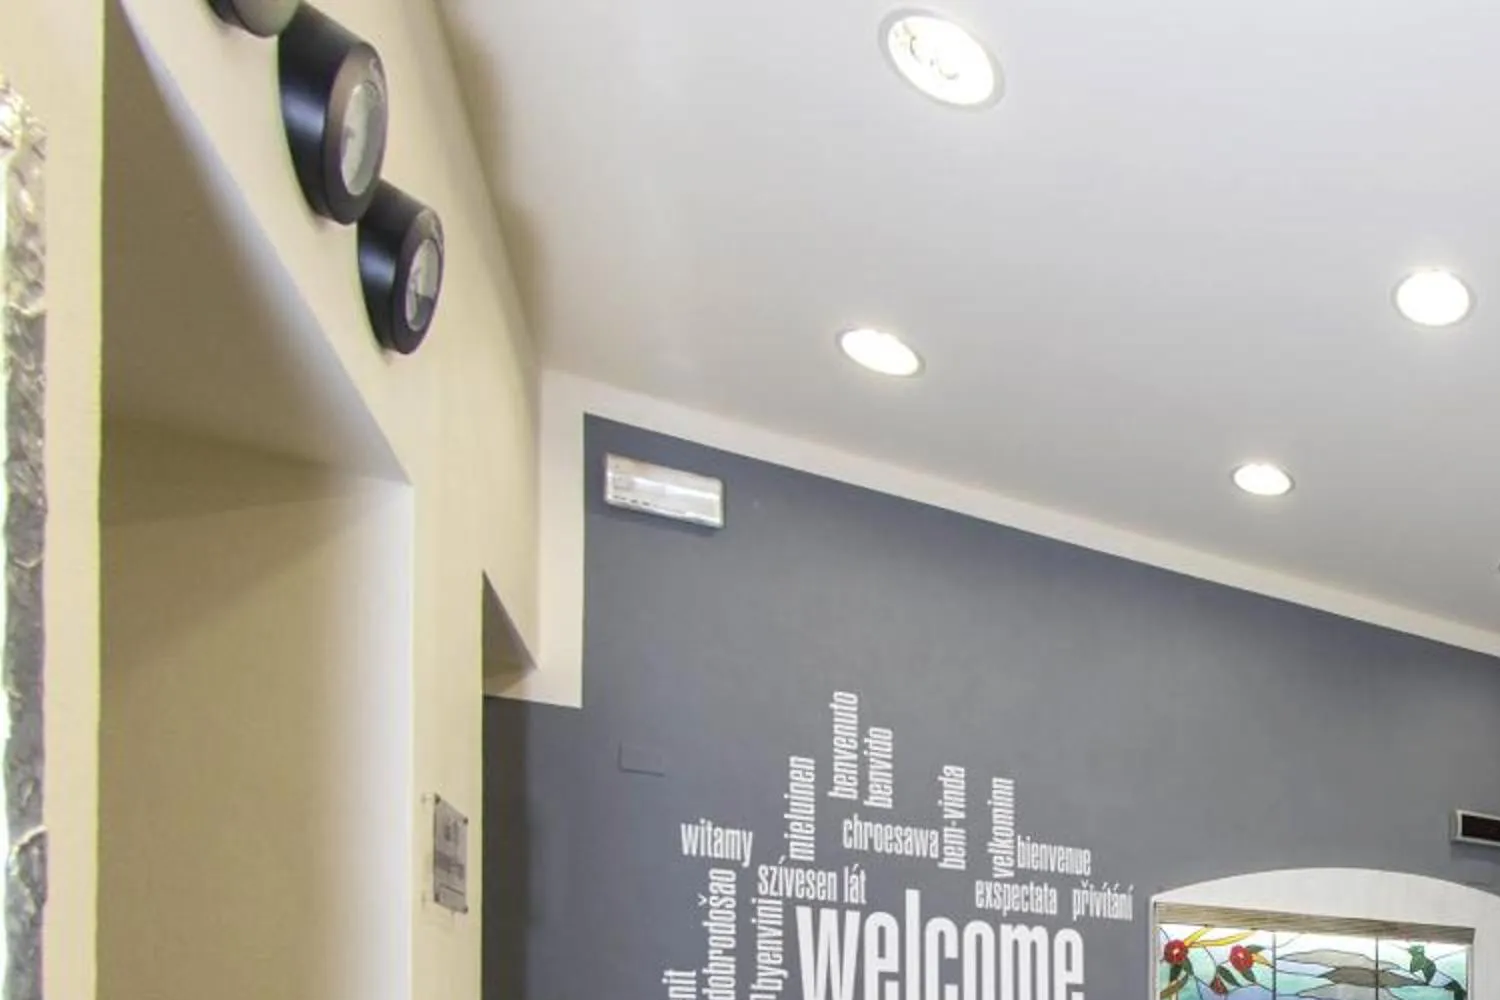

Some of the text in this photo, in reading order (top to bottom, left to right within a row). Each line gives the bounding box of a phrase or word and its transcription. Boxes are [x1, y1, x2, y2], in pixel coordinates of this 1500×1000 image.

[827, 691, 859, 800] benvenuto
[863, 726, 894, 809] benvido
[784, 755, 816, 862] mieluinen
[842, 813, 940, 859] chroesawa
[986, 776, 1015, 879] velkominn
[679, 817, 754, 868] witamy
[1016, 834, 1092, 876] bienvenue
[757, 854, 867, 905] szívesen lát
[974, 879, 1058, 917] exspectata
[751, 897, 789, 991] byenvini
